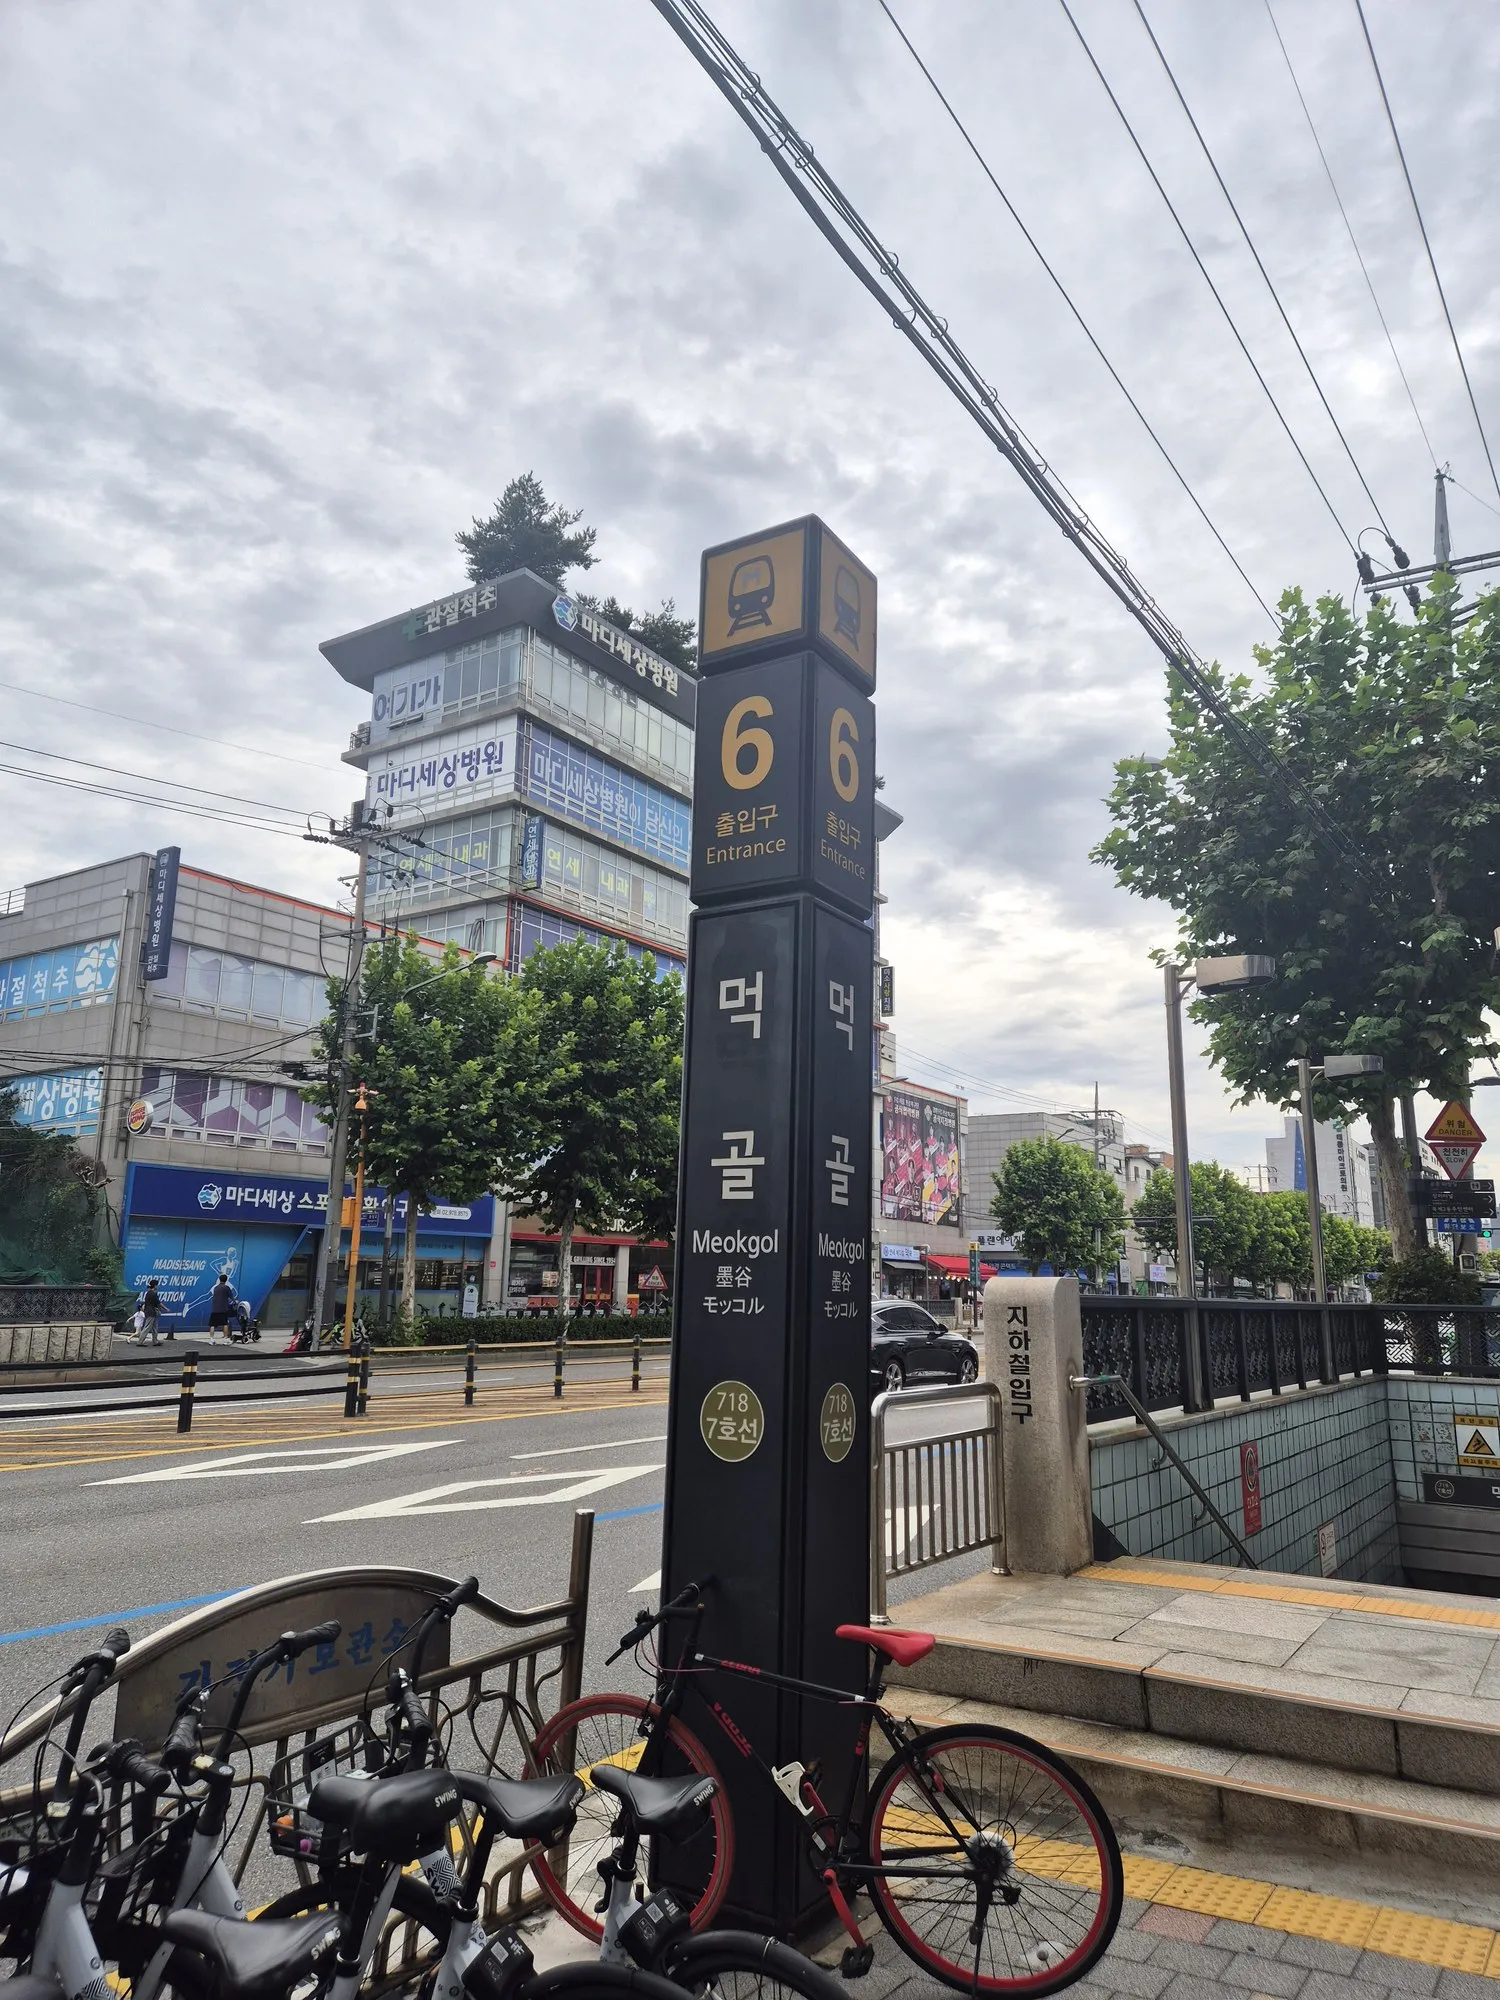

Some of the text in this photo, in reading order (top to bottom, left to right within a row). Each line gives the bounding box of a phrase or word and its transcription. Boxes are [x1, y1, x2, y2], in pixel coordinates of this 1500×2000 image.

[423, 584, 498, 632] 관절척추
[581, 611, 680, 698] 마디세상병원
[373, 671, 442, 723] 여기가
[721, 695, 774, 790] 6
[829, 707, 859, 802] 6
[376, 740, 505, 798] 마디세상병원
[534, 750, 683, 846] 마디세상병원이 당신의
[714, 804, 779, 838] 출입구
[826, 809, 862, 851] 출입구
[454, 840, 488, 865] 내과
[706, 838, 787, 865] Entrance
[820, 838, 866, 881] Entrance
[547, 847, 629, 897] 연세 내과
[152, 868, 167, 947] 마디세상병원
[711, 970, 765, 1200] 먹골
[825, 979, 856, 1207] 먹골
[1438, 1128, 1473, 1137] DANGER
[1446, 1119, 1466, 1129] 위험
[1442, 1147, 1468, 1157] 천천히
[1445, 1156, 1465, 1164] SLOW
[225, 1185, 296, 1214] 마디세상
[692, 1228, 779, 1259] Meokgol
[818, 1232, 865, 1262] Meokgol
[152, 1258, 207, 1271] MADISESANG
[715, 1265, 753, 1289] 墨谷
[134, 1275, 200, 1287] SPORTS INJURY
[831, 1270, 852, 1293] 墨谷
[702, 1296, 765, 1316] モッコル
[824, 1300, 859, 1319] モッコル
[1007, 1304, 1033, 1425] 지하철입구
[716, 1391, 749, 1413] 718
[829, 1394, 848, 1414] 718
[706, 1417, 758, 1445] 7호선
[823, 1416, 852, 1444] 7호선
[434, 1788, 458, 1808] SWING
[693, 1784, 714, 1806] SWING
[310, 1926, 341, 1961] SWING
